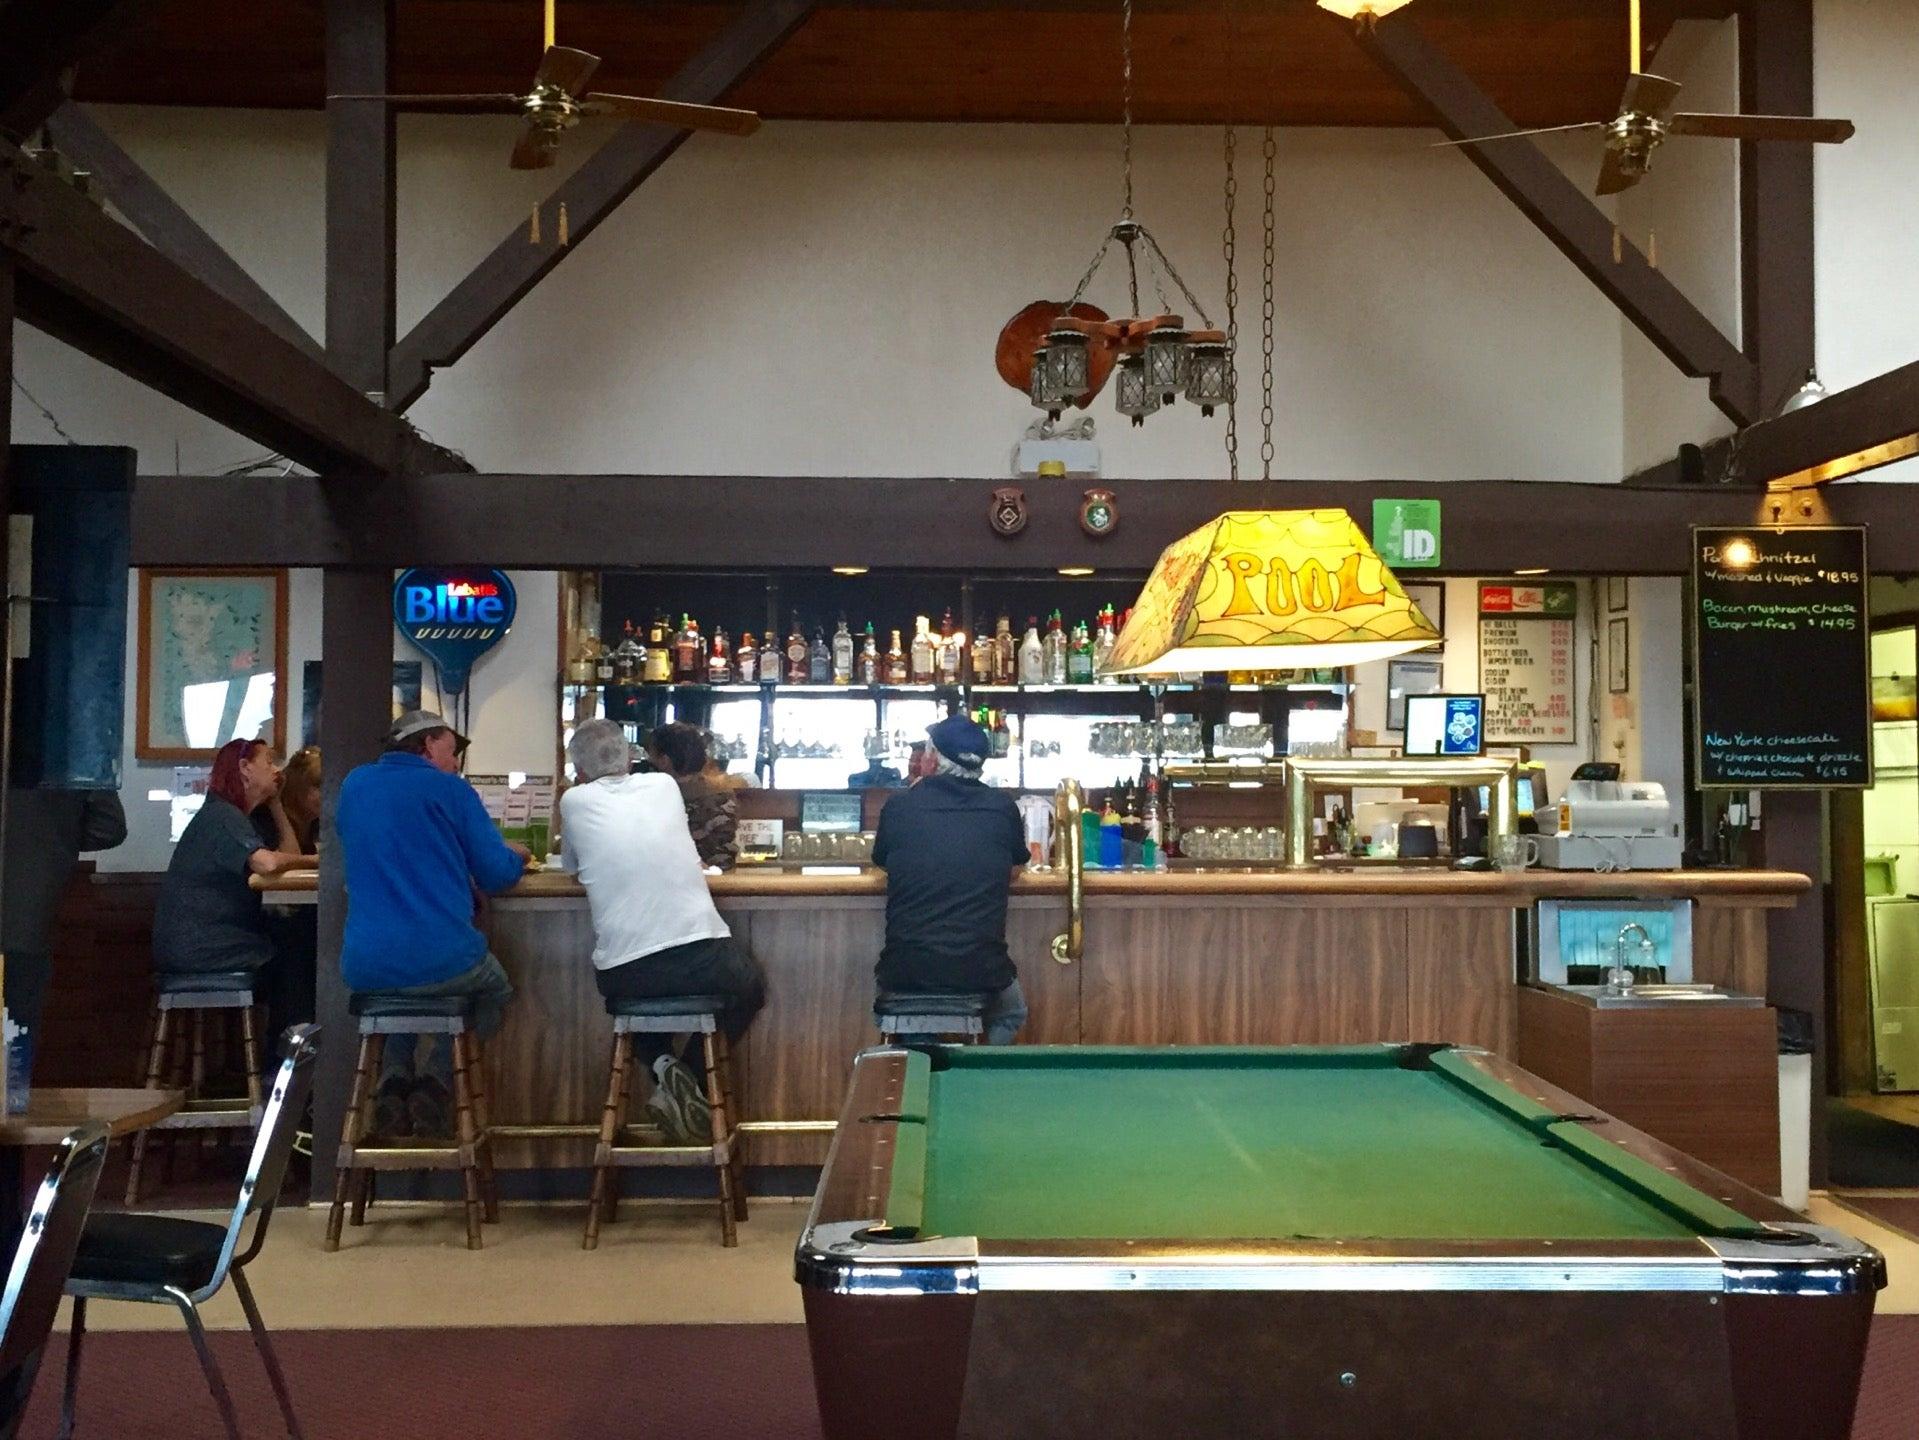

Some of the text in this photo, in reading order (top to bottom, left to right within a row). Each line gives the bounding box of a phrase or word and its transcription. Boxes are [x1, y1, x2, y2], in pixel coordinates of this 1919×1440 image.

[1403, 529, 1436, 559] ID
[1221, 552, 1387, 617] POOL
[405, 584, 504, 624] Blue
[1705, 732, 1732, 746] New
[1734, 731, 1764, 747] York
